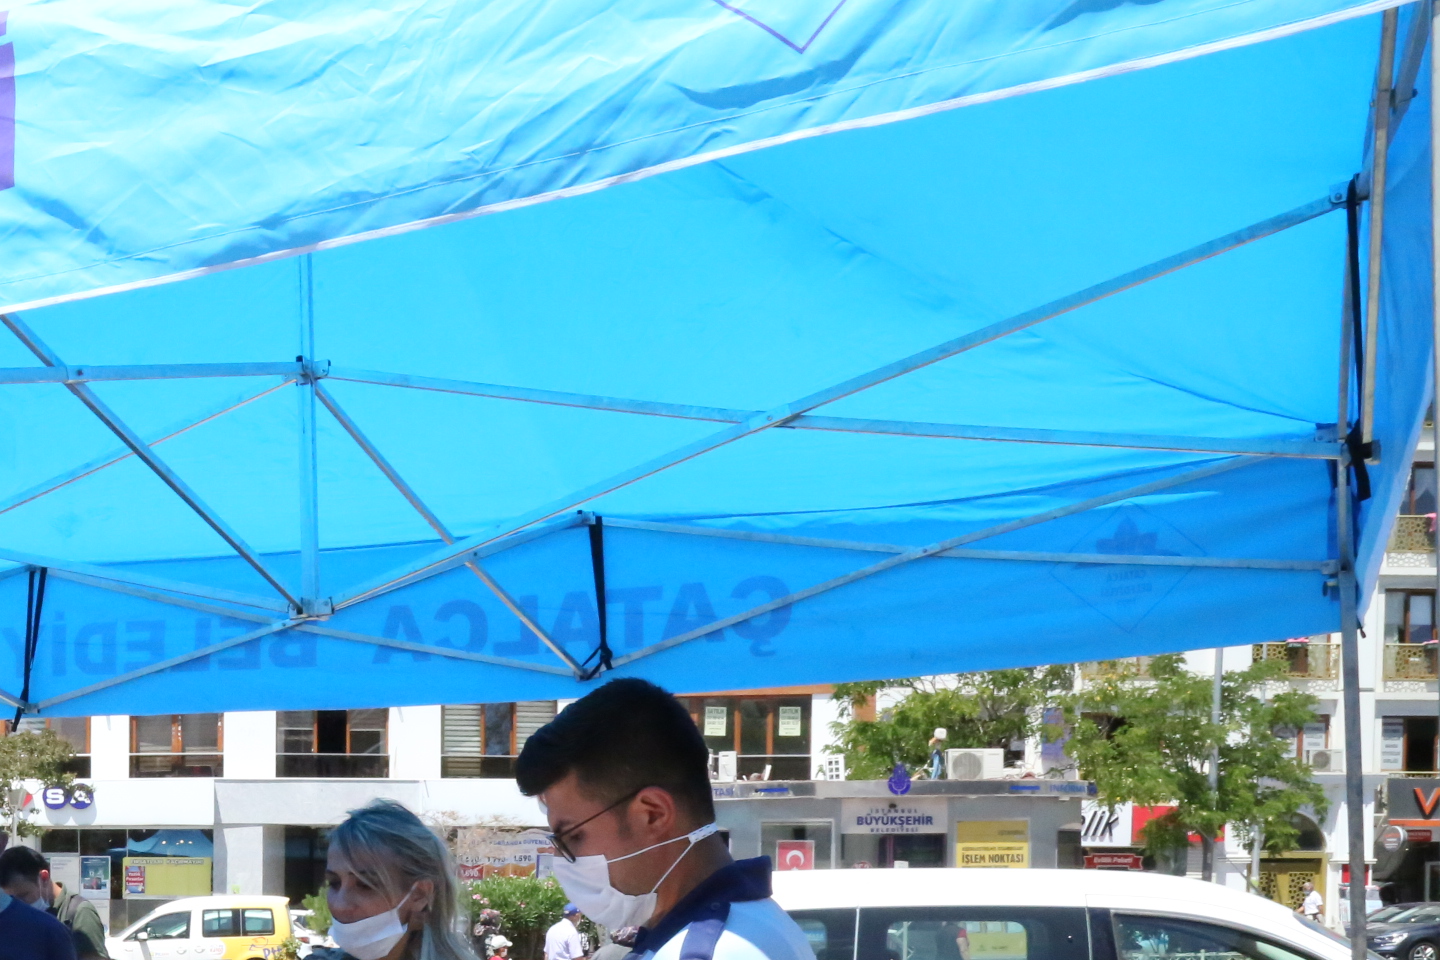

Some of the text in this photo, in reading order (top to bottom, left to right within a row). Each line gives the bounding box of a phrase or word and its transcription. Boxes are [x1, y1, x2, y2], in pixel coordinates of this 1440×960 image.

[856, 813, 933, 827] BÜYÜKŞEHİR
[962, 852, 1024, 865] İŞLEM NOKTASI
